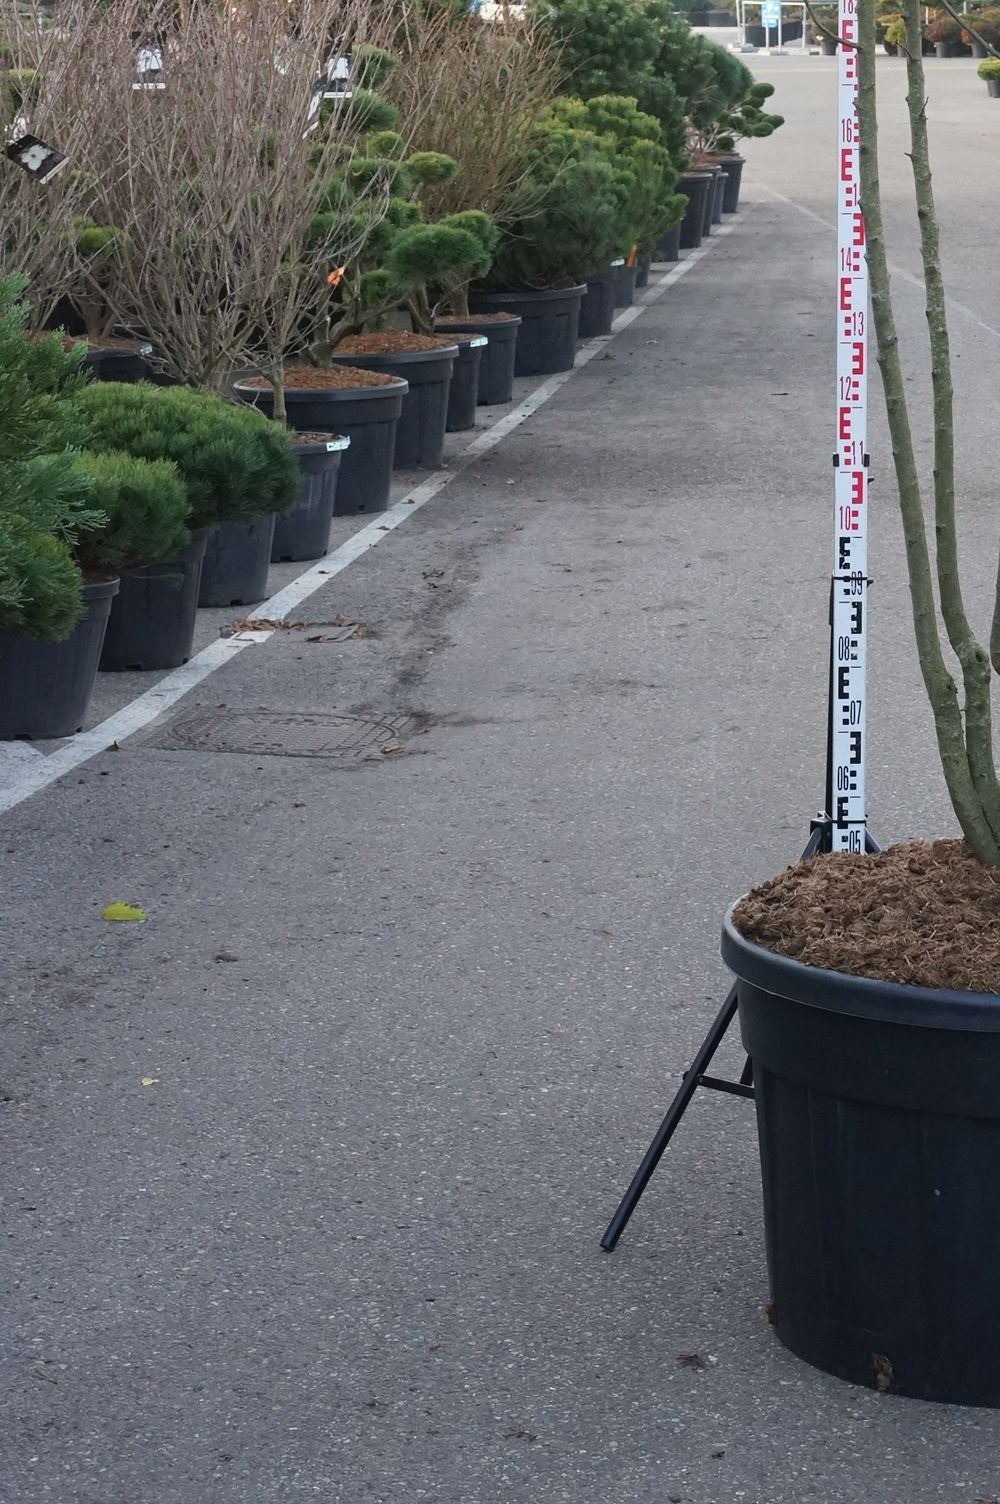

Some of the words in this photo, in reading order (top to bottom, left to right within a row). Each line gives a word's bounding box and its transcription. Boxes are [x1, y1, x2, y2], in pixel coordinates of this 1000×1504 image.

[841, 118, 852, 143] 16
[840, 247, 852, 271] 14
[853, 311, 864, 336] 13
[840, 376, 851, 401] 12
[852, 441, 864, 465] 11
[839, 506, 851, 530] 10
[851, 570, 863, 595] 09
[838, 636, 850, 661] 08
[850, 700, 862, 725] 07
[837, 766, 849, 791] 06
[849, 830, 861, 853] 05
